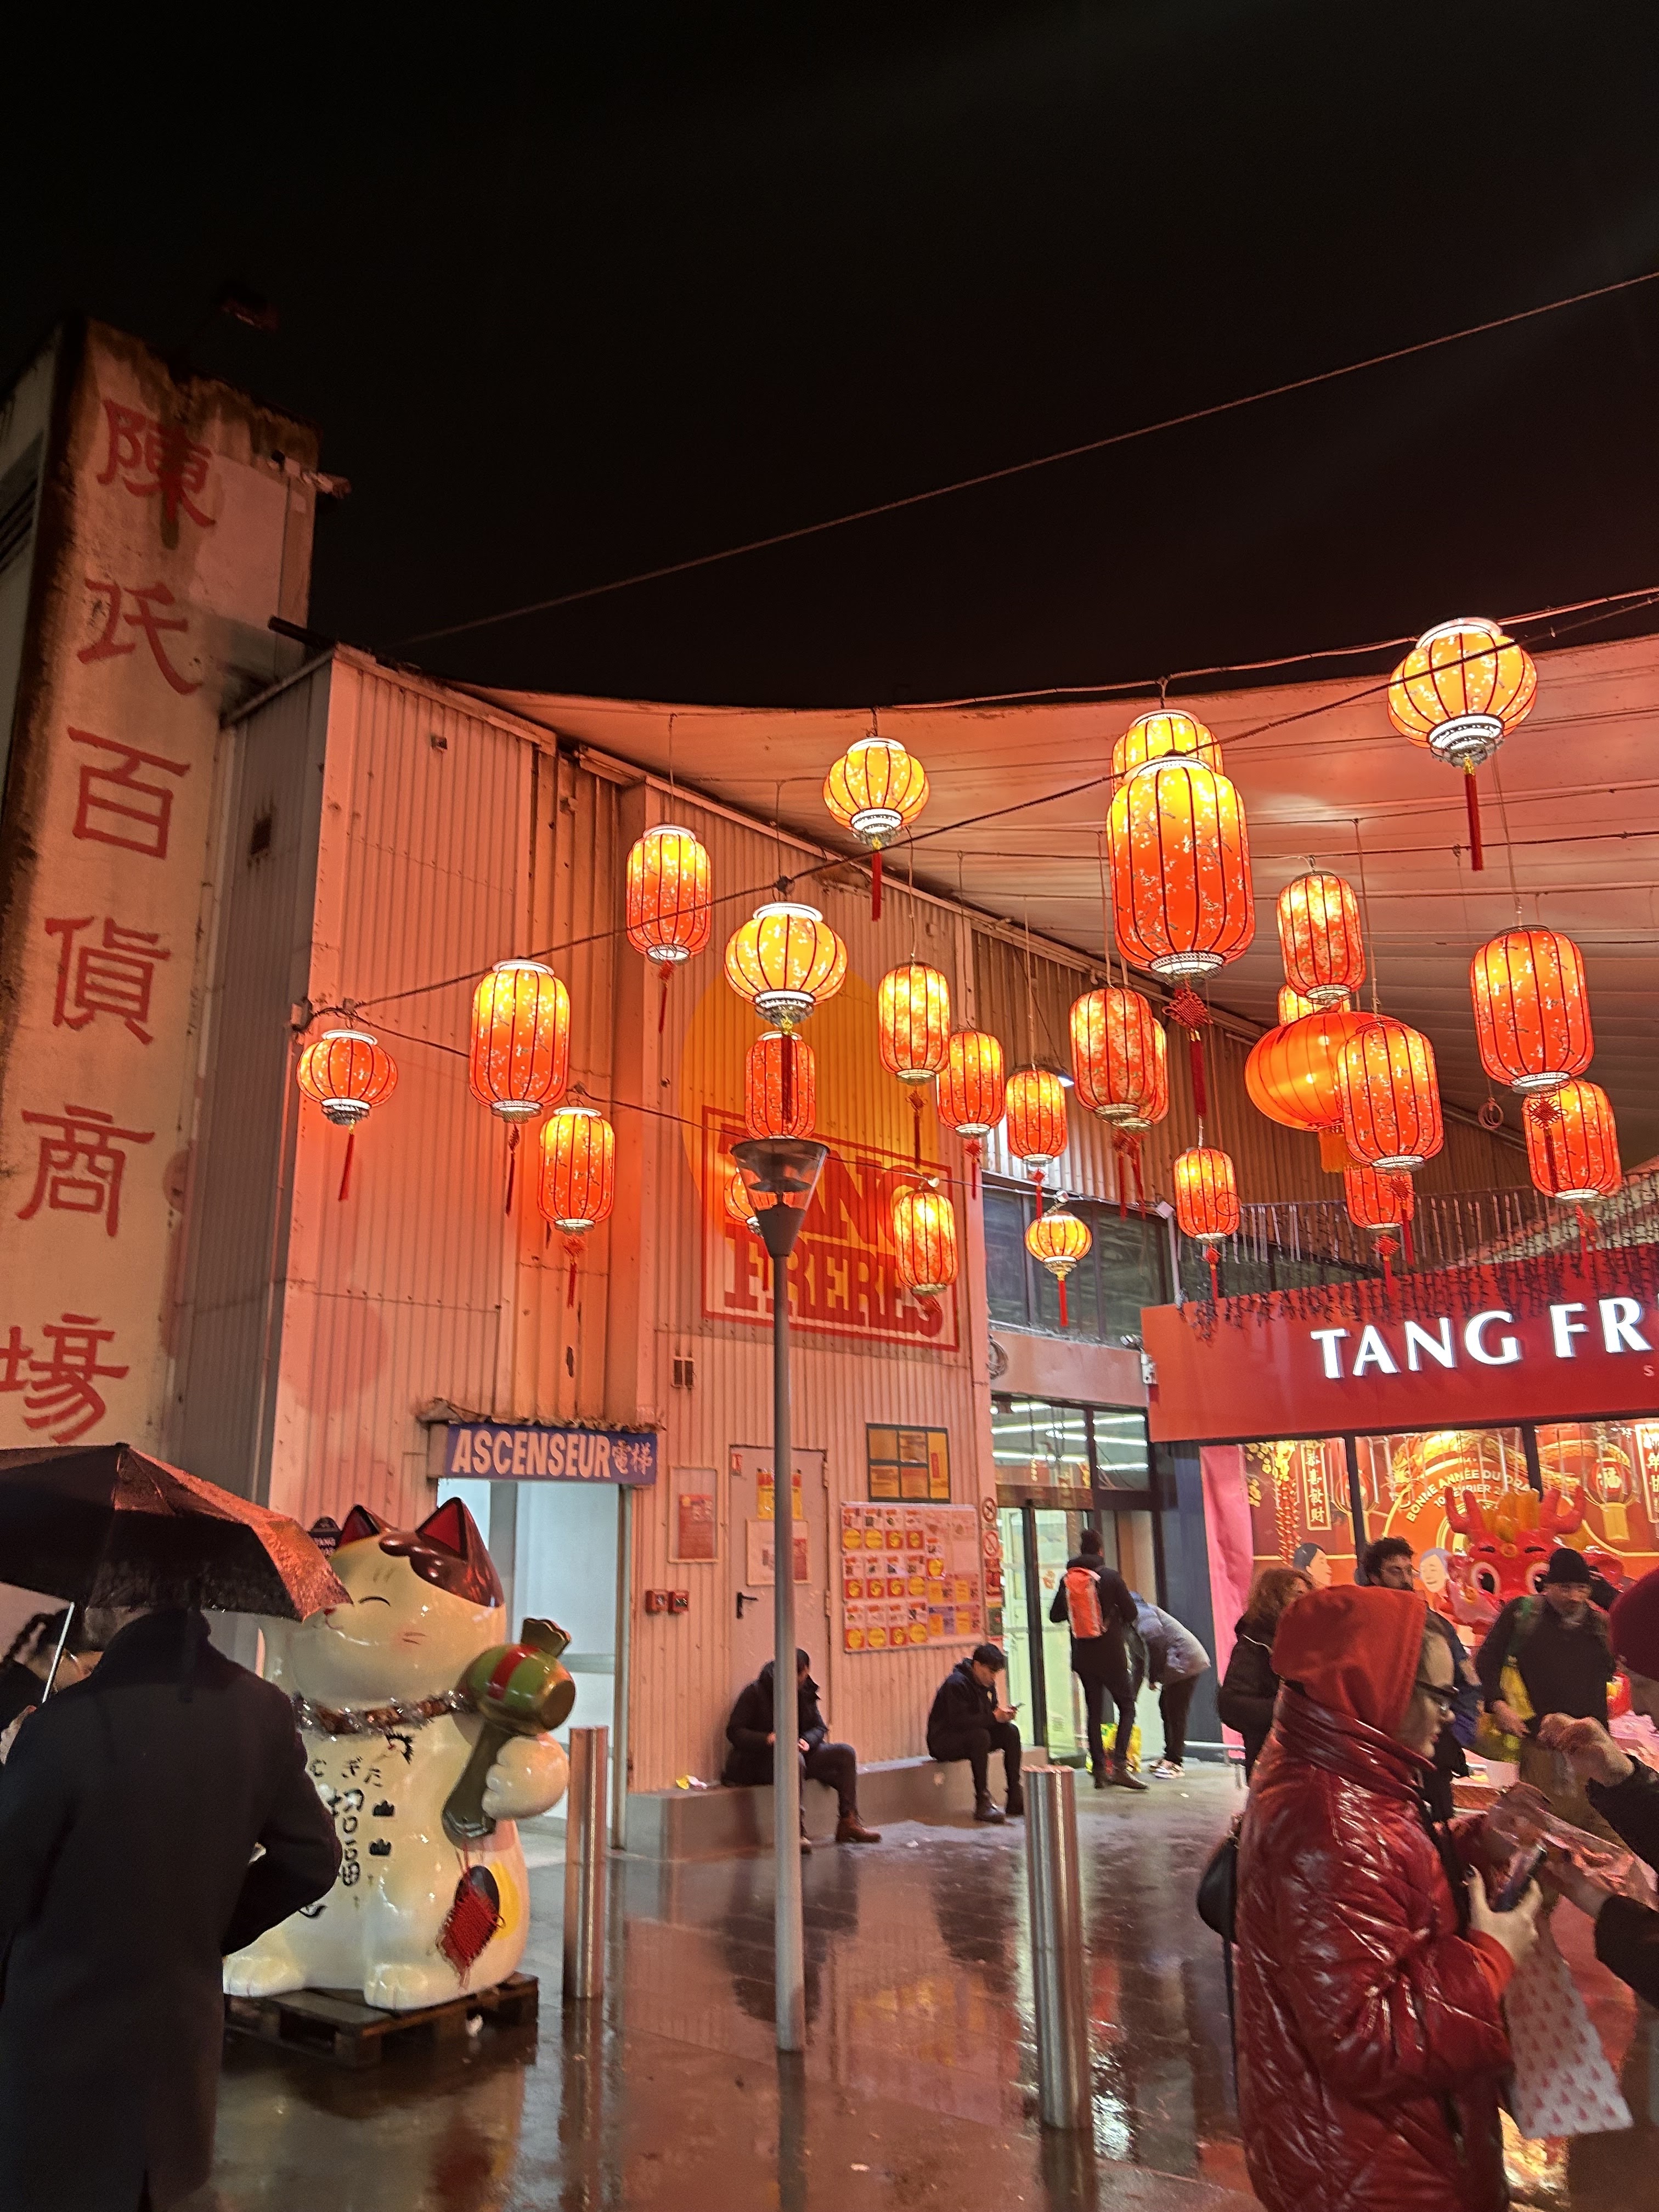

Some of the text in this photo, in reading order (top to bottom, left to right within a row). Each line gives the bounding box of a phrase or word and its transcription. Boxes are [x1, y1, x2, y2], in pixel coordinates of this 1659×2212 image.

[1310, 1297, 1659, 1379] TANG FR
[450, 1429, 611, 1478] ASCENSEUR
[1406, 1483, 1438, 1523] BONNE
[1438, 1468, 1480, 1490] ANNÉE
[1482, 1469, 1502, 1481] DU
[1505, 1474, 1531, 1493] DRA
[1434, 1496, 1446, 1508] 10
